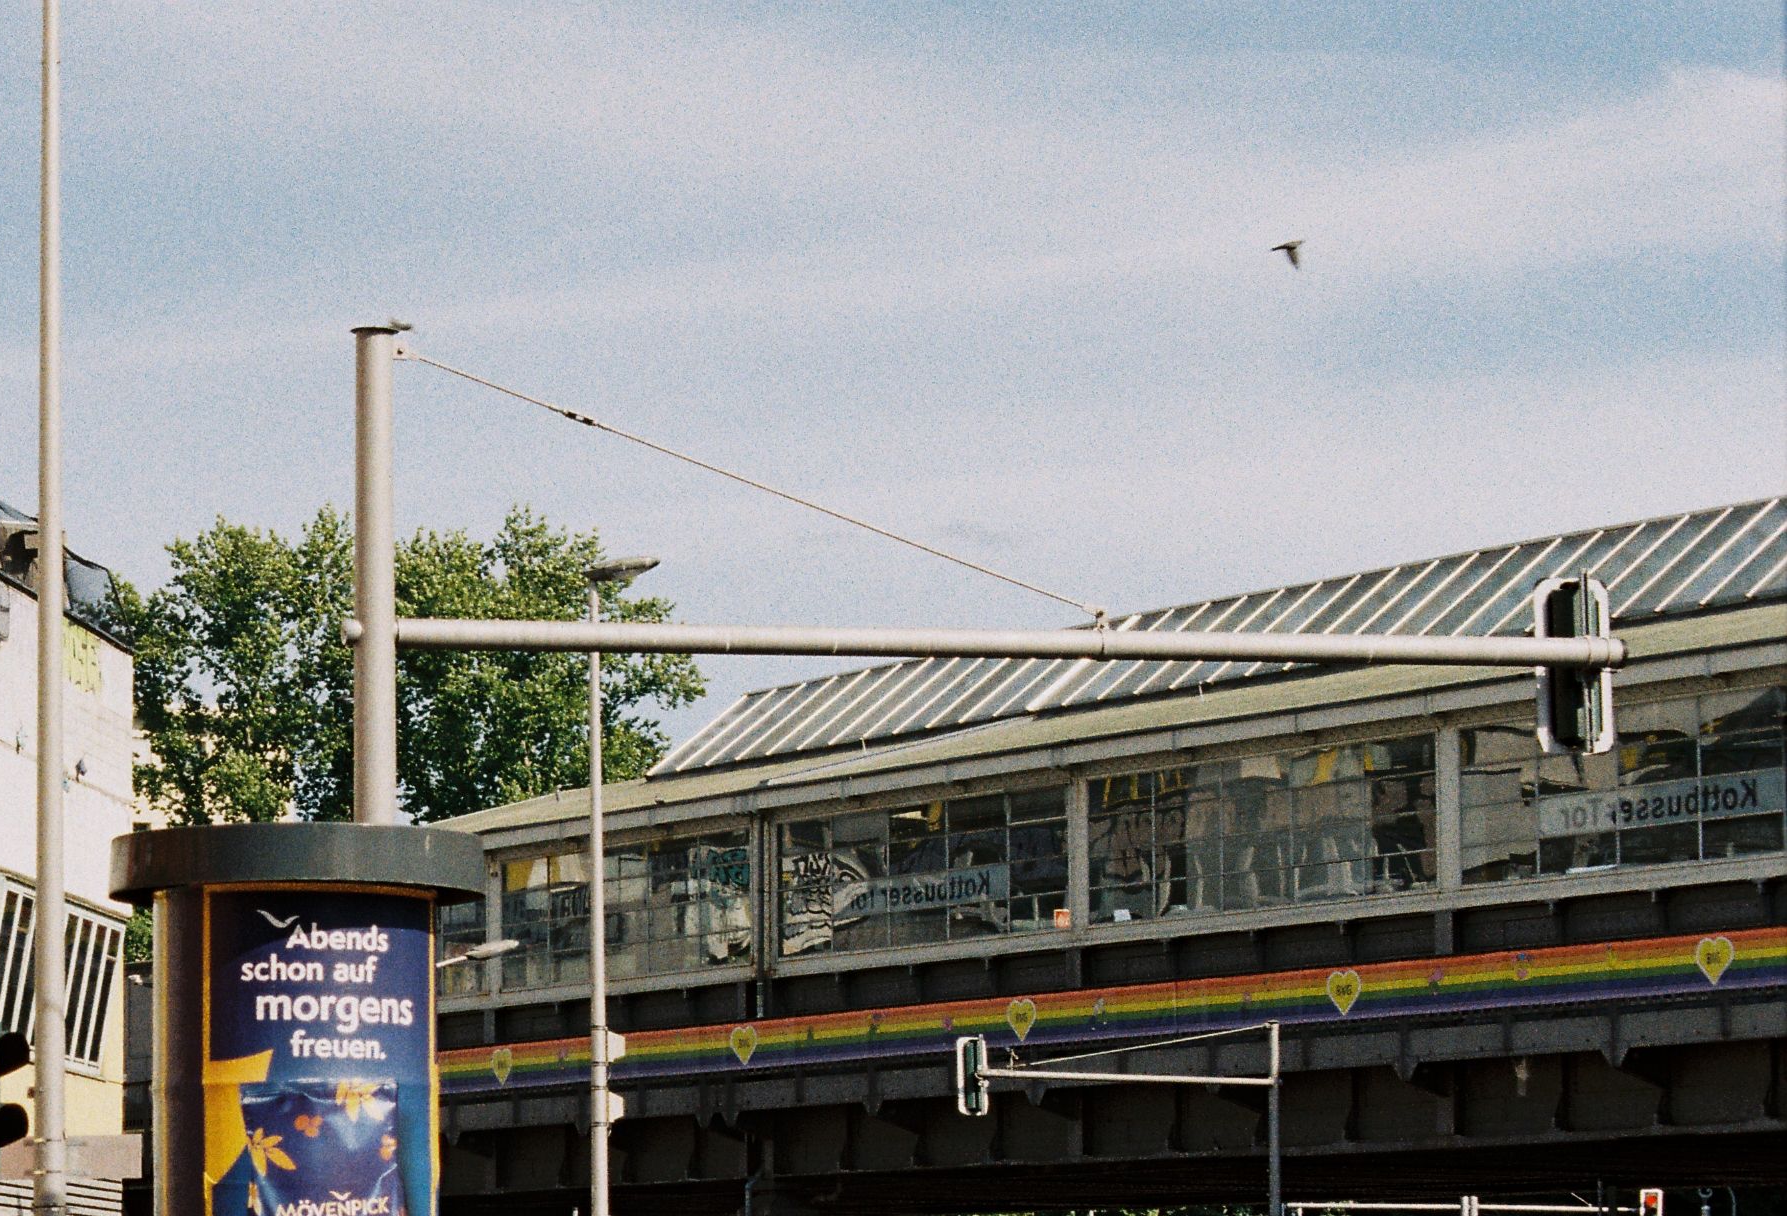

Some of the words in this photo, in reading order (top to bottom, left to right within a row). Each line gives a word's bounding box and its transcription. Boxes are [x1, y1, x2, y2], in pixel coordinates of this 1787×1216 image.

[285, 922, 389, 952] Abends
[240, 953, 324, 982] schon
[332, 955, 379, 983] auf
[255, 994, 414, 1034] morgens
[289, 1029, 387, 1060] freuen.
